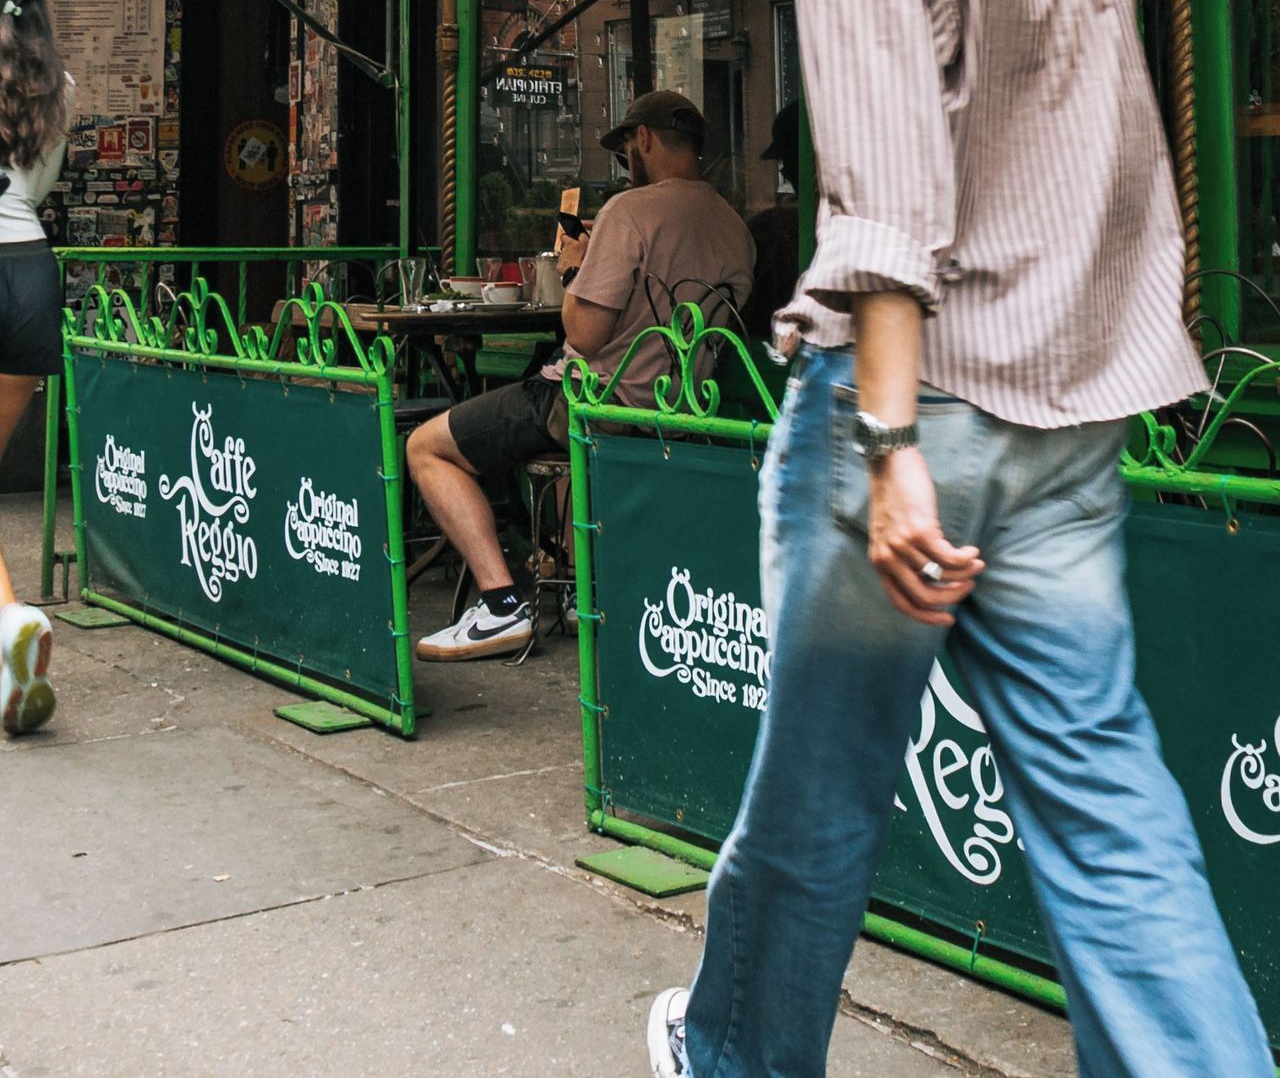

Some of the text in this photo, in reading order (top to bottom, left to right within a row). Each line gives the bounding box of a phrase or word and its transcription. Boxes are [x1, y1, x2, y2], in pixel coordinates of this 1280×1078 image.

[95, 454, 148, 503] Cappuccino
[104, 434, 145, 474] Original
[190, 400, 257, 525] Caffe
[115, 496, 133, 516] Since
[299, 476, 359, 530] Original
[159, 473, 258, 603] Reggio
[284, 500, 362, 564] Cappuccino
[314, 551, 361, 582] Since 1927
[666, 566, 768, 642] Origina
[691, 666, 768, 713] Since 192
